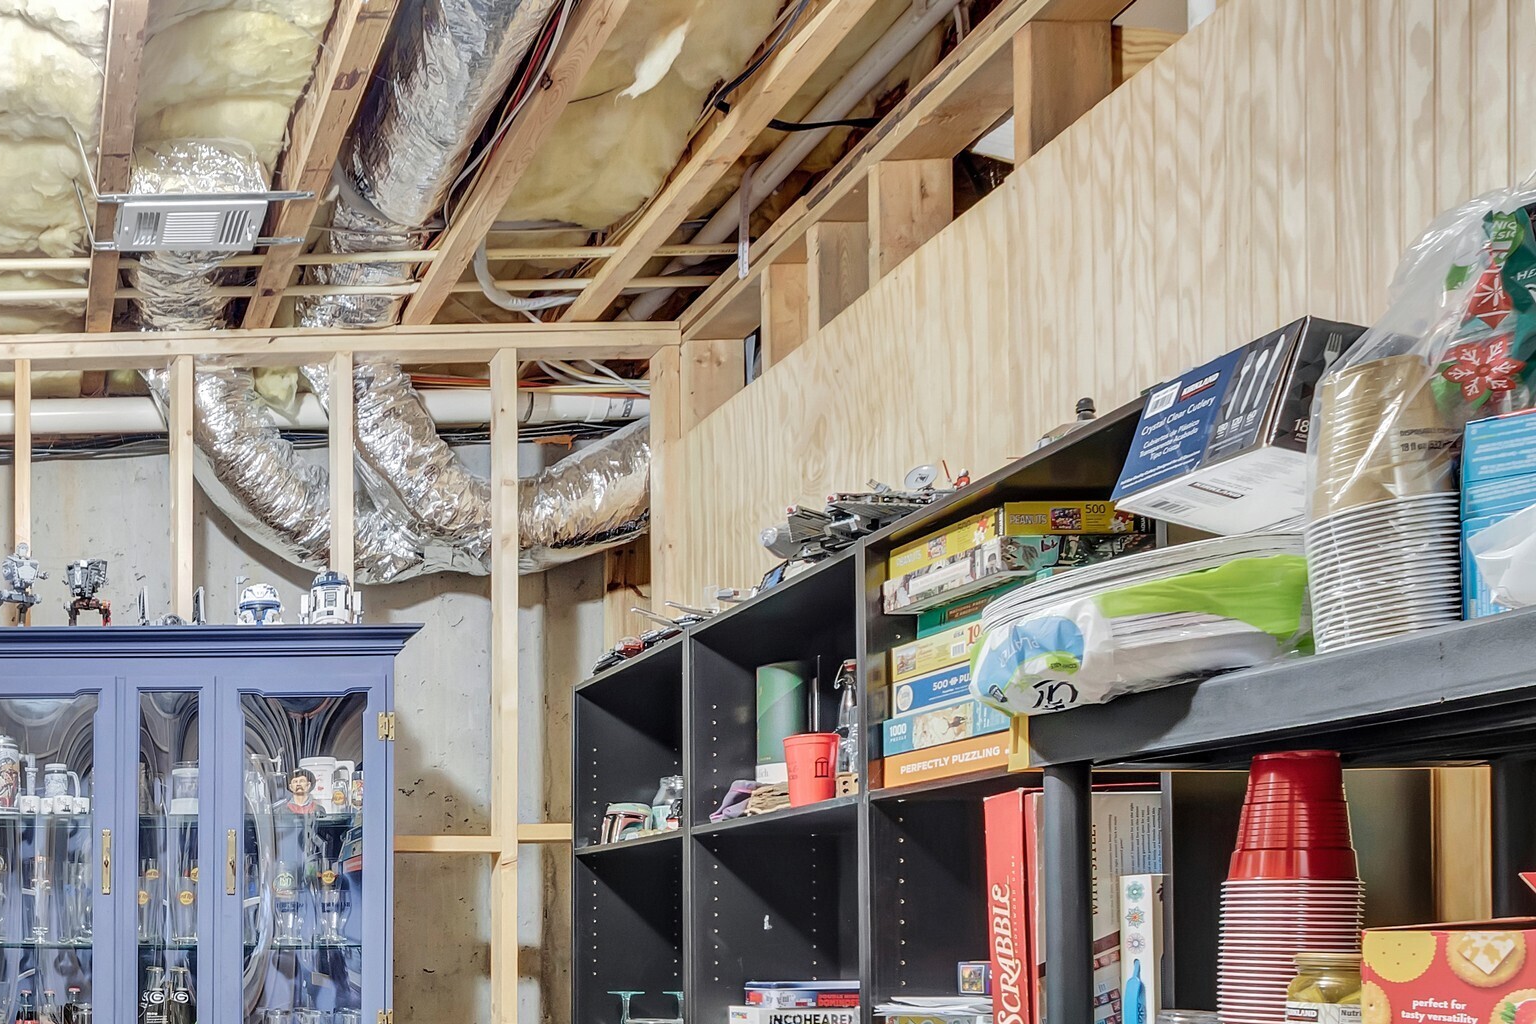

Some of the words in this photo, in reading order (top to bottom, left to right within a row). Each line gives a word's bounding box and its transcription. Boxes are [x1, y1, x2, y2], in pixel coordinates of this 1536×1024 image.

[1182, 372, 1219, 396] KIRKLAND
[1141, 417, 1166, 436] Crystal
[1166, 408, 1185, 426] Clear
[1186, 396, 1216, 413] Cutlery
[1085, 504, 1106, 515] 500
[1009, 514, 1048, 526] PEANUTS
[932, 680, 949, 692] 500
[889, 723, 908, 737] 1000
[900, 756, 949, 775] PERFECTLY
[951, 746, 1000, 765] PUZZLING
[1412, 998, 1449, 1010] perfect
[1450, 999, 1467, 1010] for
[1401, 1010, 1425, 1023] tasty
